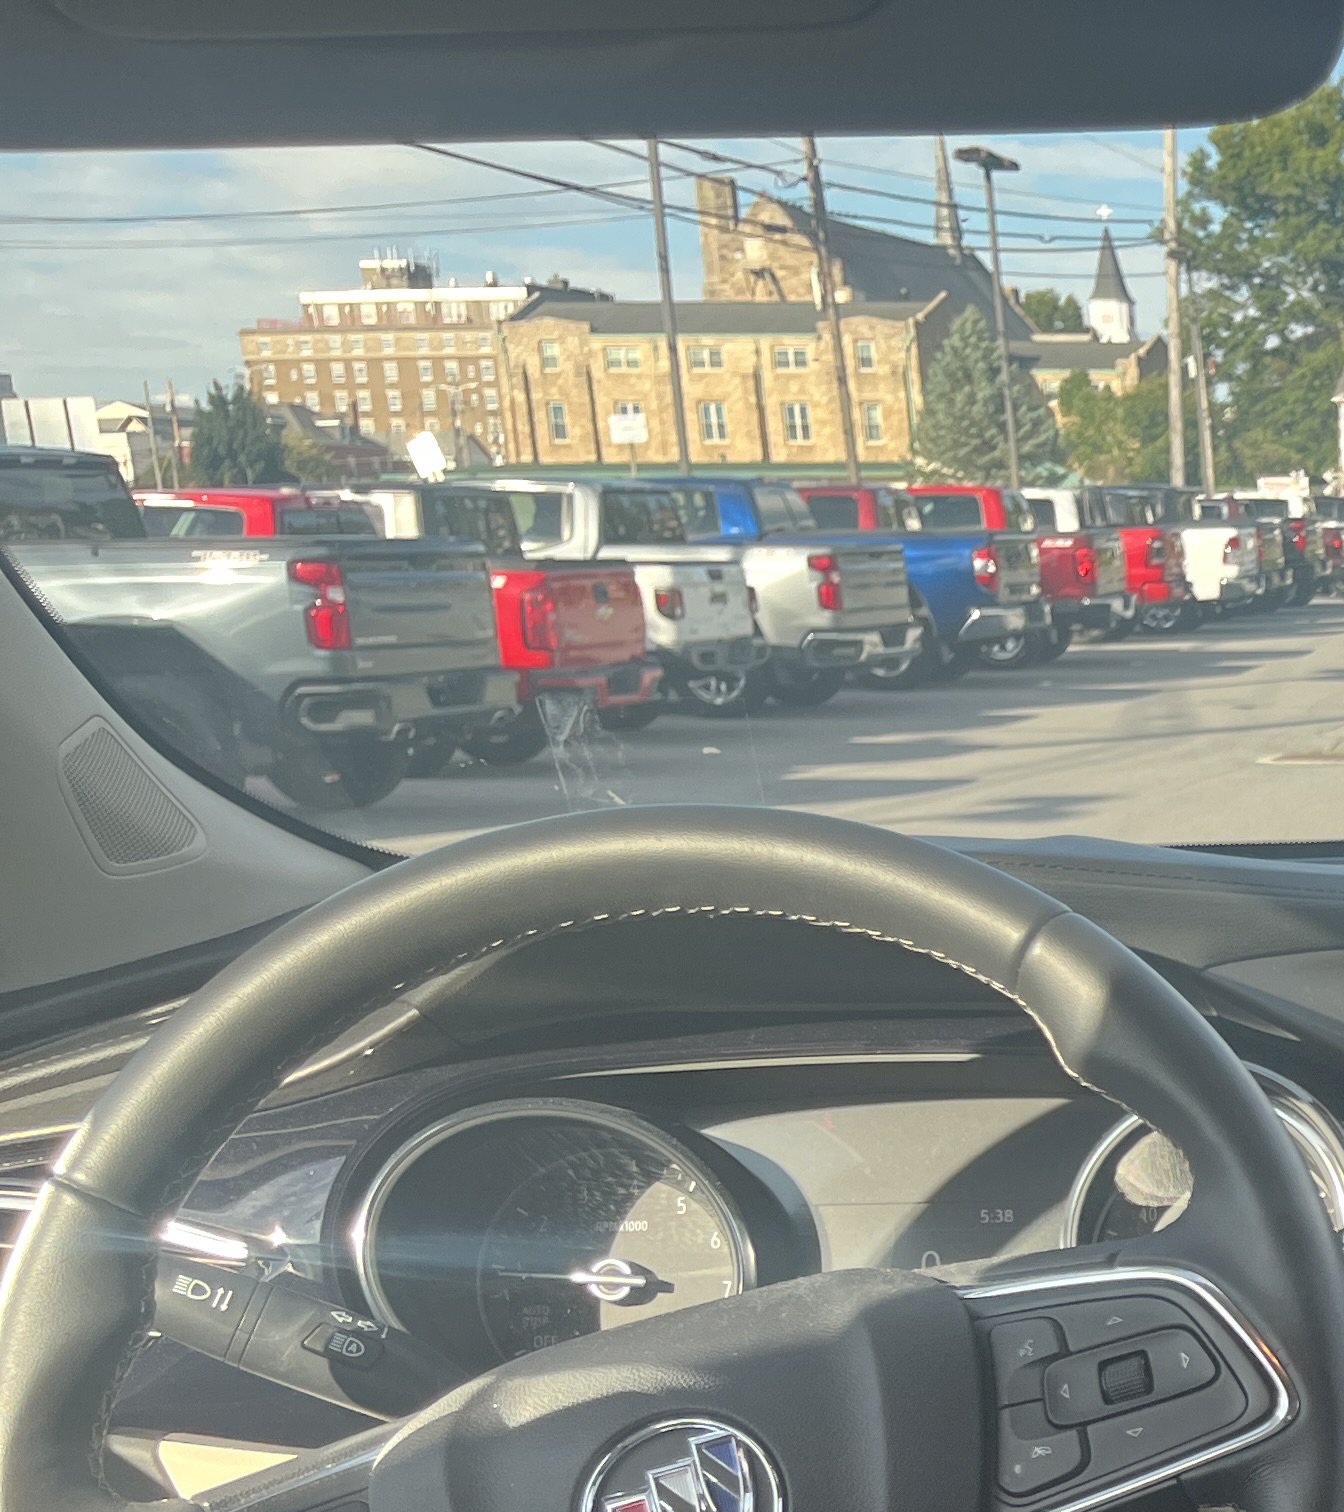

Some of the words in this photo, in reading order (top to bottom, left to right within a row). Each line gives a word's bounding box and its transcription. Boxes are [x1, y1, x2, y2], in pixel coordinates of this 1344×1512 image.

[676, 1197, 687, 1215] 5
[980, 1209, 1014, 1223] 5:38
[710, 1231, 721, 1249] 6
[722, 1280, 733, 1299] 7
